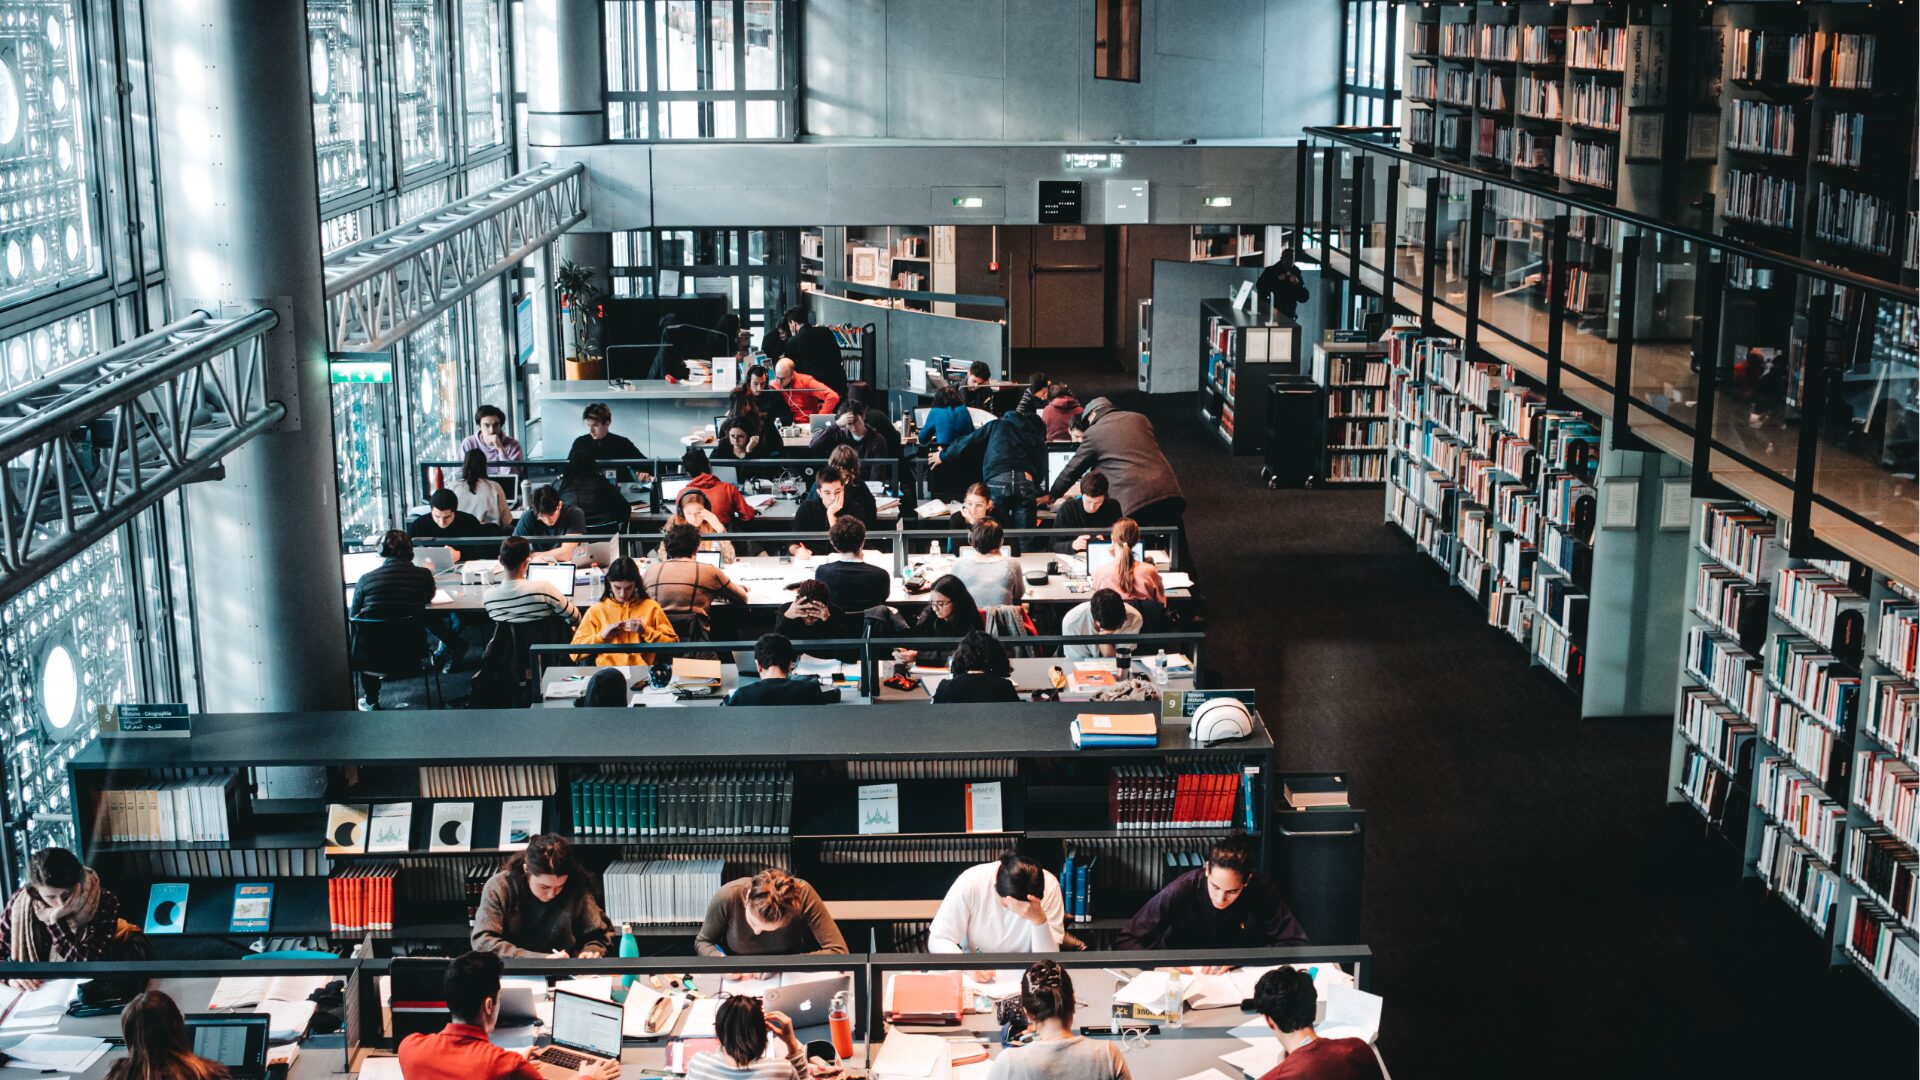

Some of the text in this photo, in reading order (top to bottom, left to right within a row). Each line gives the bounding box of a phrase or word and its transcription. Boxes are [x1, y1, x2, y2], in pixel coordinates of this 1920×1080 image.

[1632, 31, 1643, 99] Sciences sociales
[1168, 699, 1176, 709] 9
[104, 713, 112, 723] 9
[144, 710, 172, 719] Géographie
